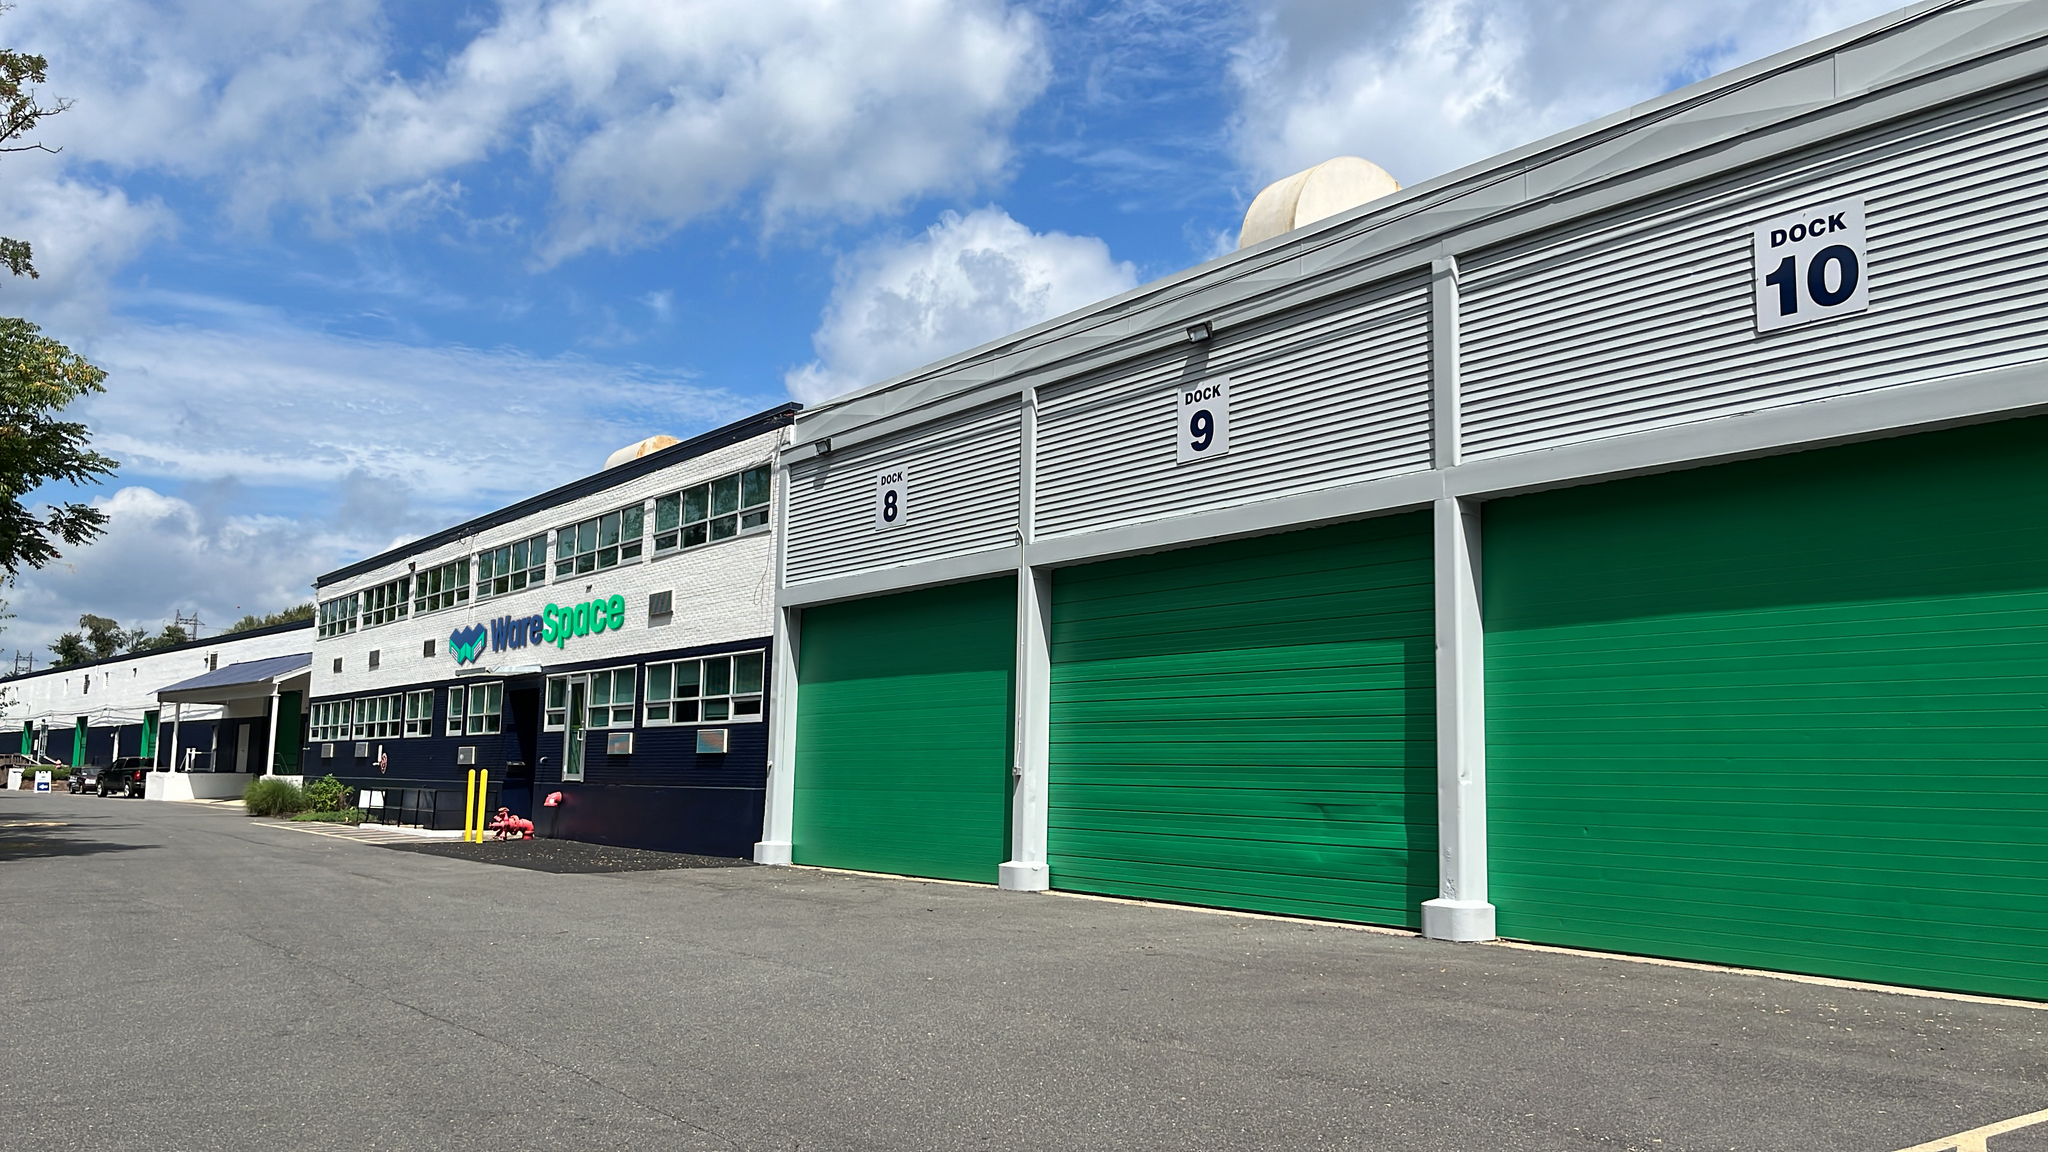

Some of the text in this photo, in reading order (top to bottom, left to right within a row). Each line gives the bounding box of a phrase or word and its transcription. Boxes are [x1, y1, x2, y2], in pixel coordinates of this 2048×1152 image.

[1771, 212, 1847, 248] DOCK
[1766, 245, 1859, 316] 10
[1185, 384, 1221, 405] DOCK
[1190, 410, 1214, 451] 9
[881, 471, 902, 485] DOCK
[883, 490, 897, 522] 8
[491, 594, 625, 652] WareSpace
